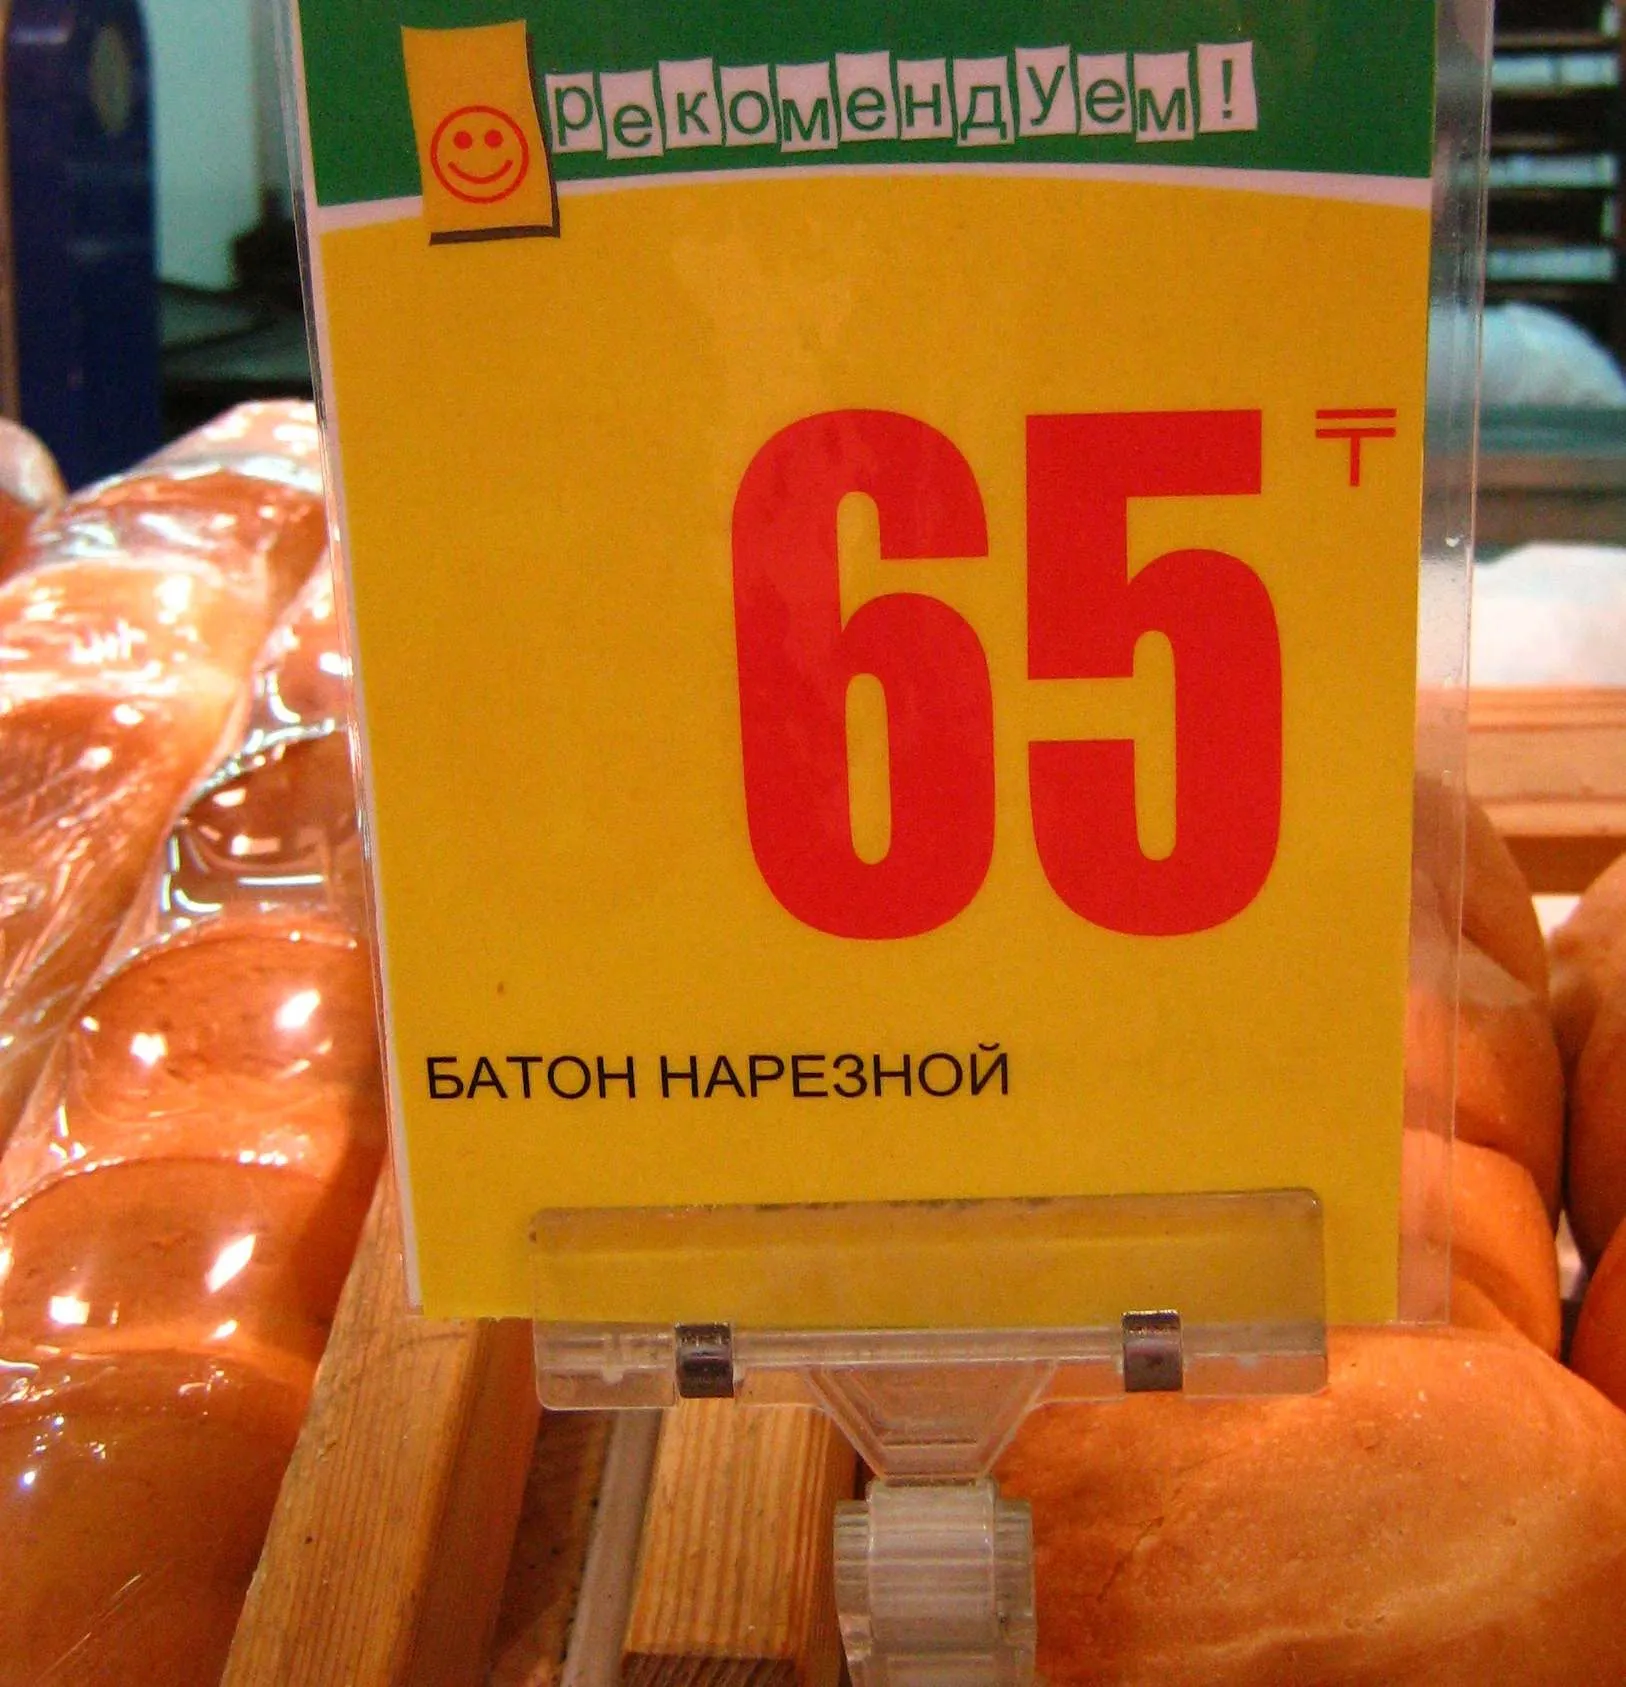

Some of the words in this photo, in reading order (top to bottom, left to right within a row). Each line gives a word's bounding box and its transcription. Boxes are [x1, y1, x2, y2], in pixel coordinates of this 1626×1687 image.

[552, 58, 1236, 147] рекомендуем!
[731, 408, 1283, 940] 65
[426, 1054, 637, 1100] БАТОН
[660, 1043, 1010, 1099] НАРЕЗНОЙ
